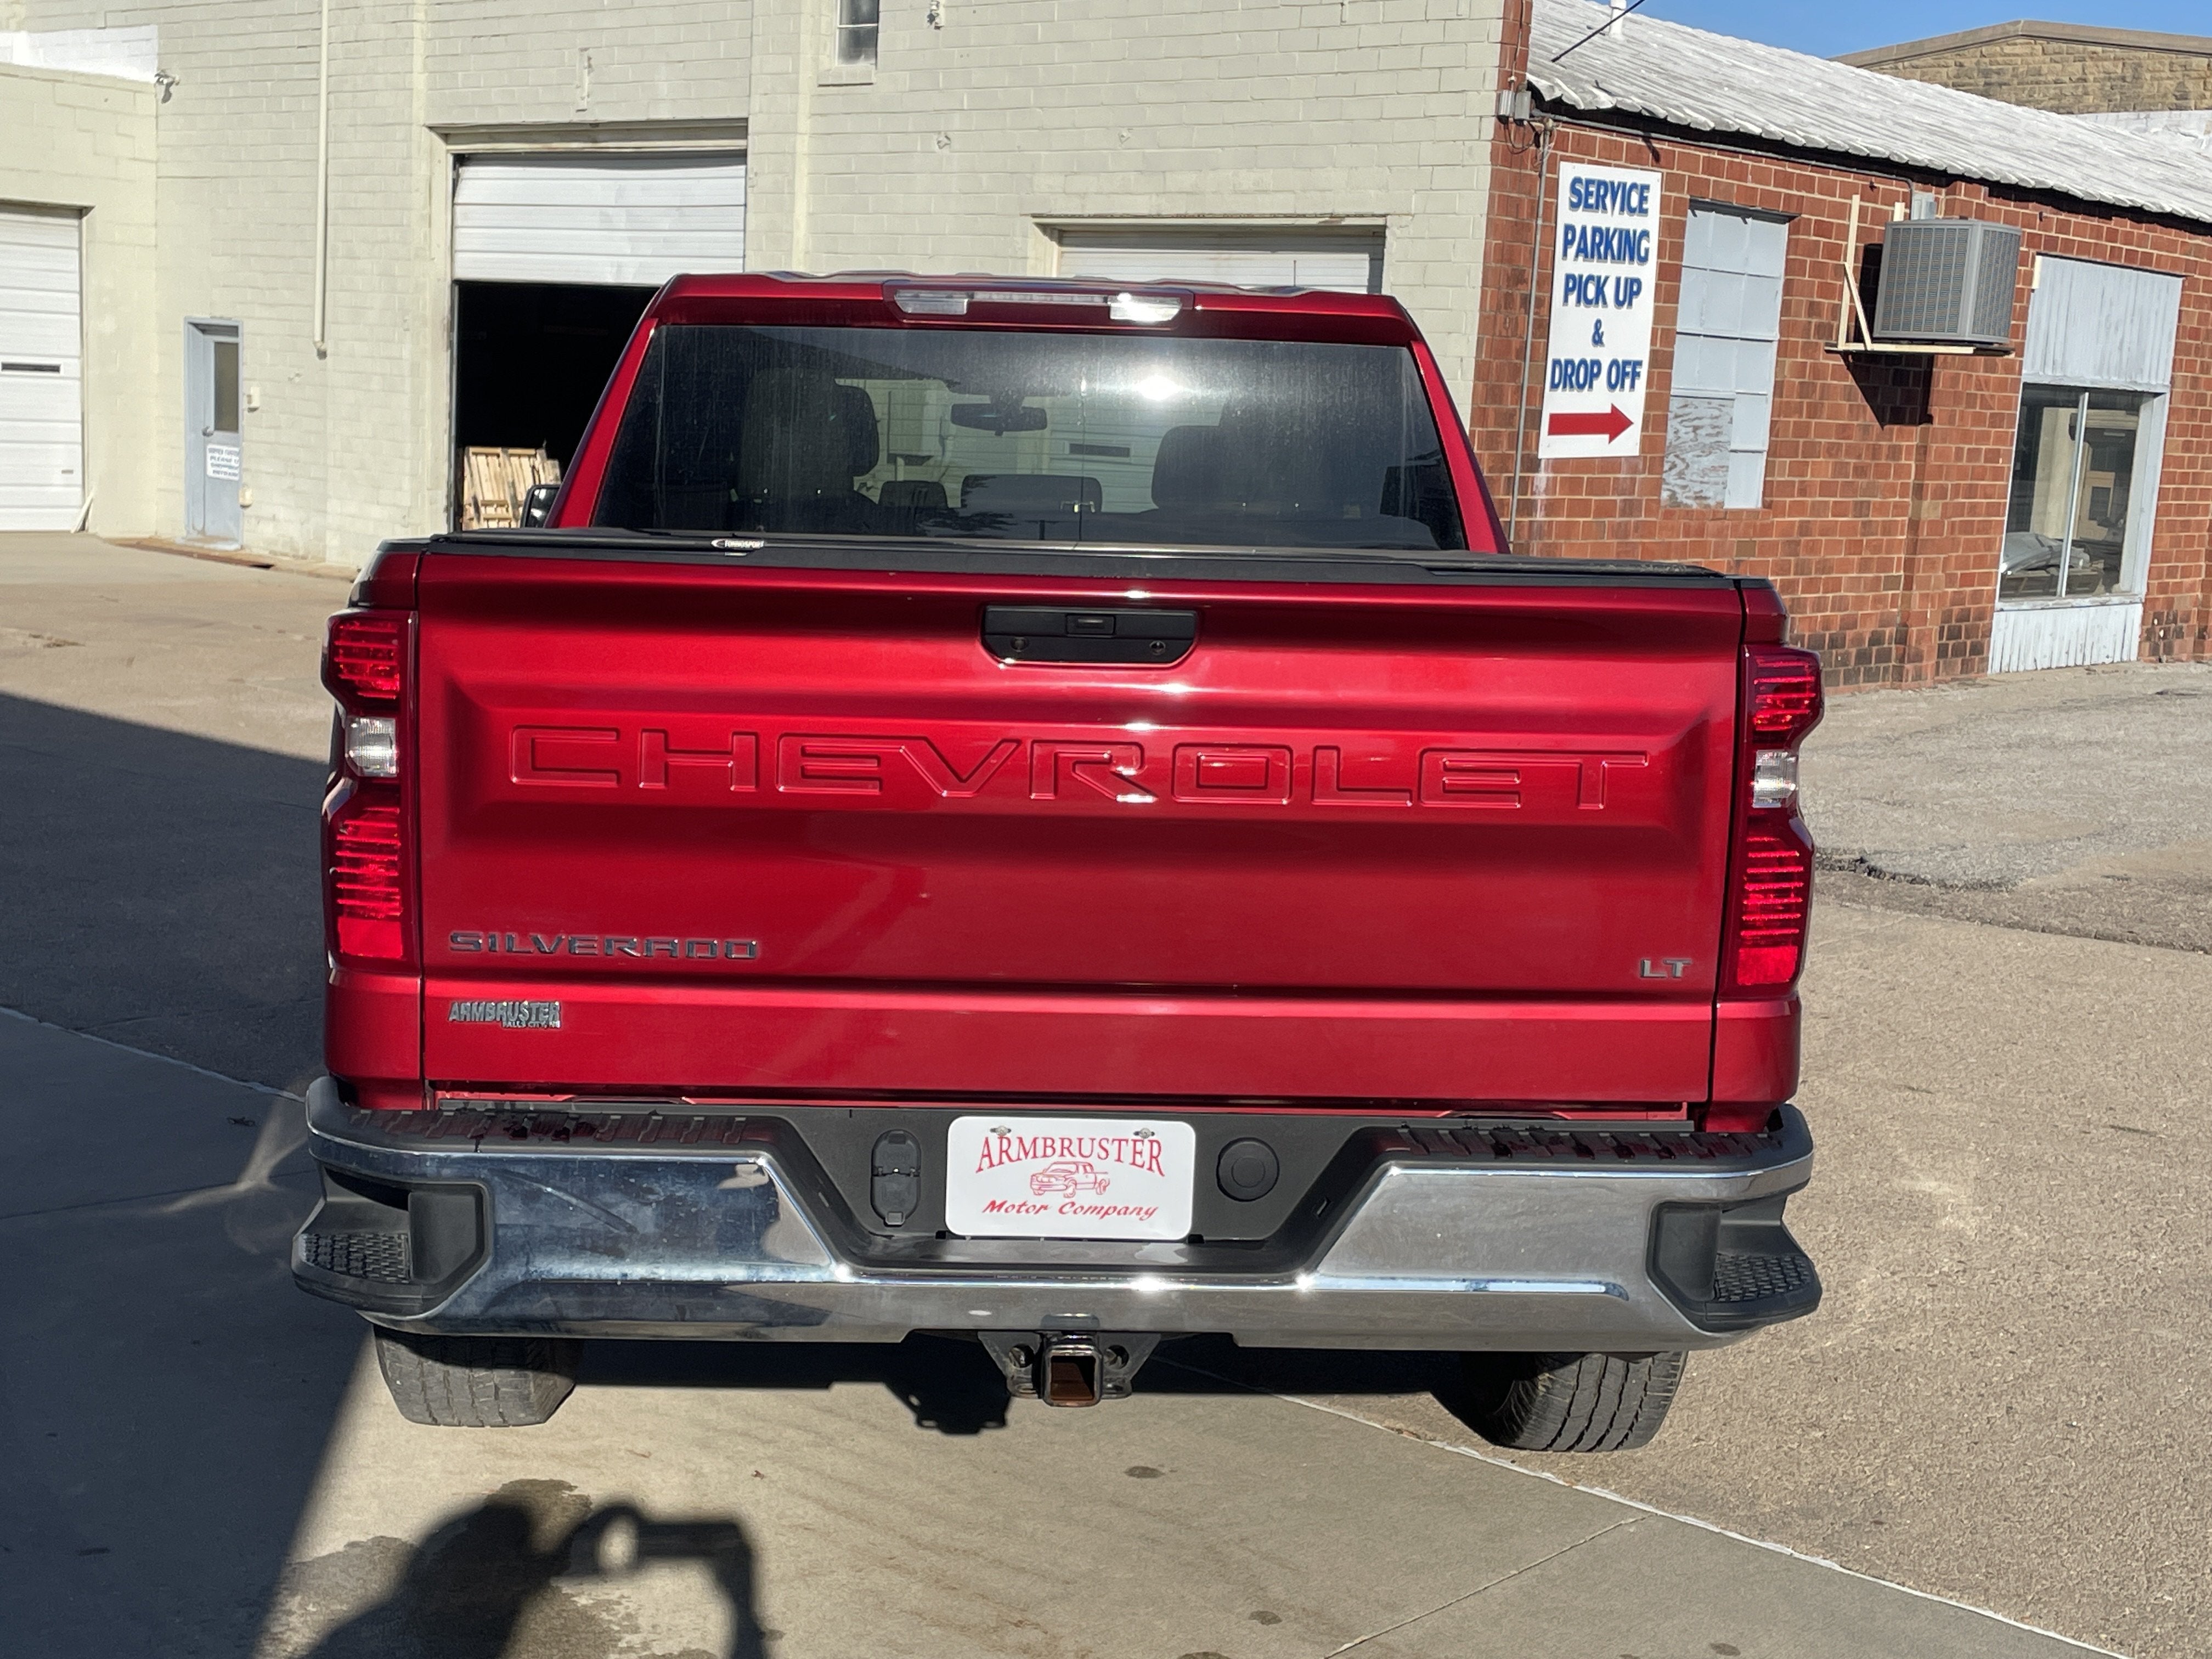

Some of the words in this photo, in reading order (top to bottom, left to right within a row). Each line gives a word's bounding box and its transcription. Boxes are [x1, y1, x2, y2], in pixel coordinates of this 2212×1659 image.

[1569, 176, 1650, 217] SERVICE
[1561, 223, 1650, 264] PARKING
[1563, 273, 1609, 308] PICK
[1615, 276, 1642, 309] UP
[1592, 318, 1605, 347] &
[1549, 358, 1601, 392] DROP
[1607, 359, 1643, 392] OFF
[510, 724, 1648, 809] CHEVROLET
[449, 931, 758, 959] SILVERADO
[1640, 959, 1691, 978] LT
[449, 1001, 560, 1022] ARMBRUSTER
[975, 1136, 1165, 1177] ARMBRUSTER
[982, 1199, 1049, 1215] Motor
[1058, 1201, 1159, 1221] Company
